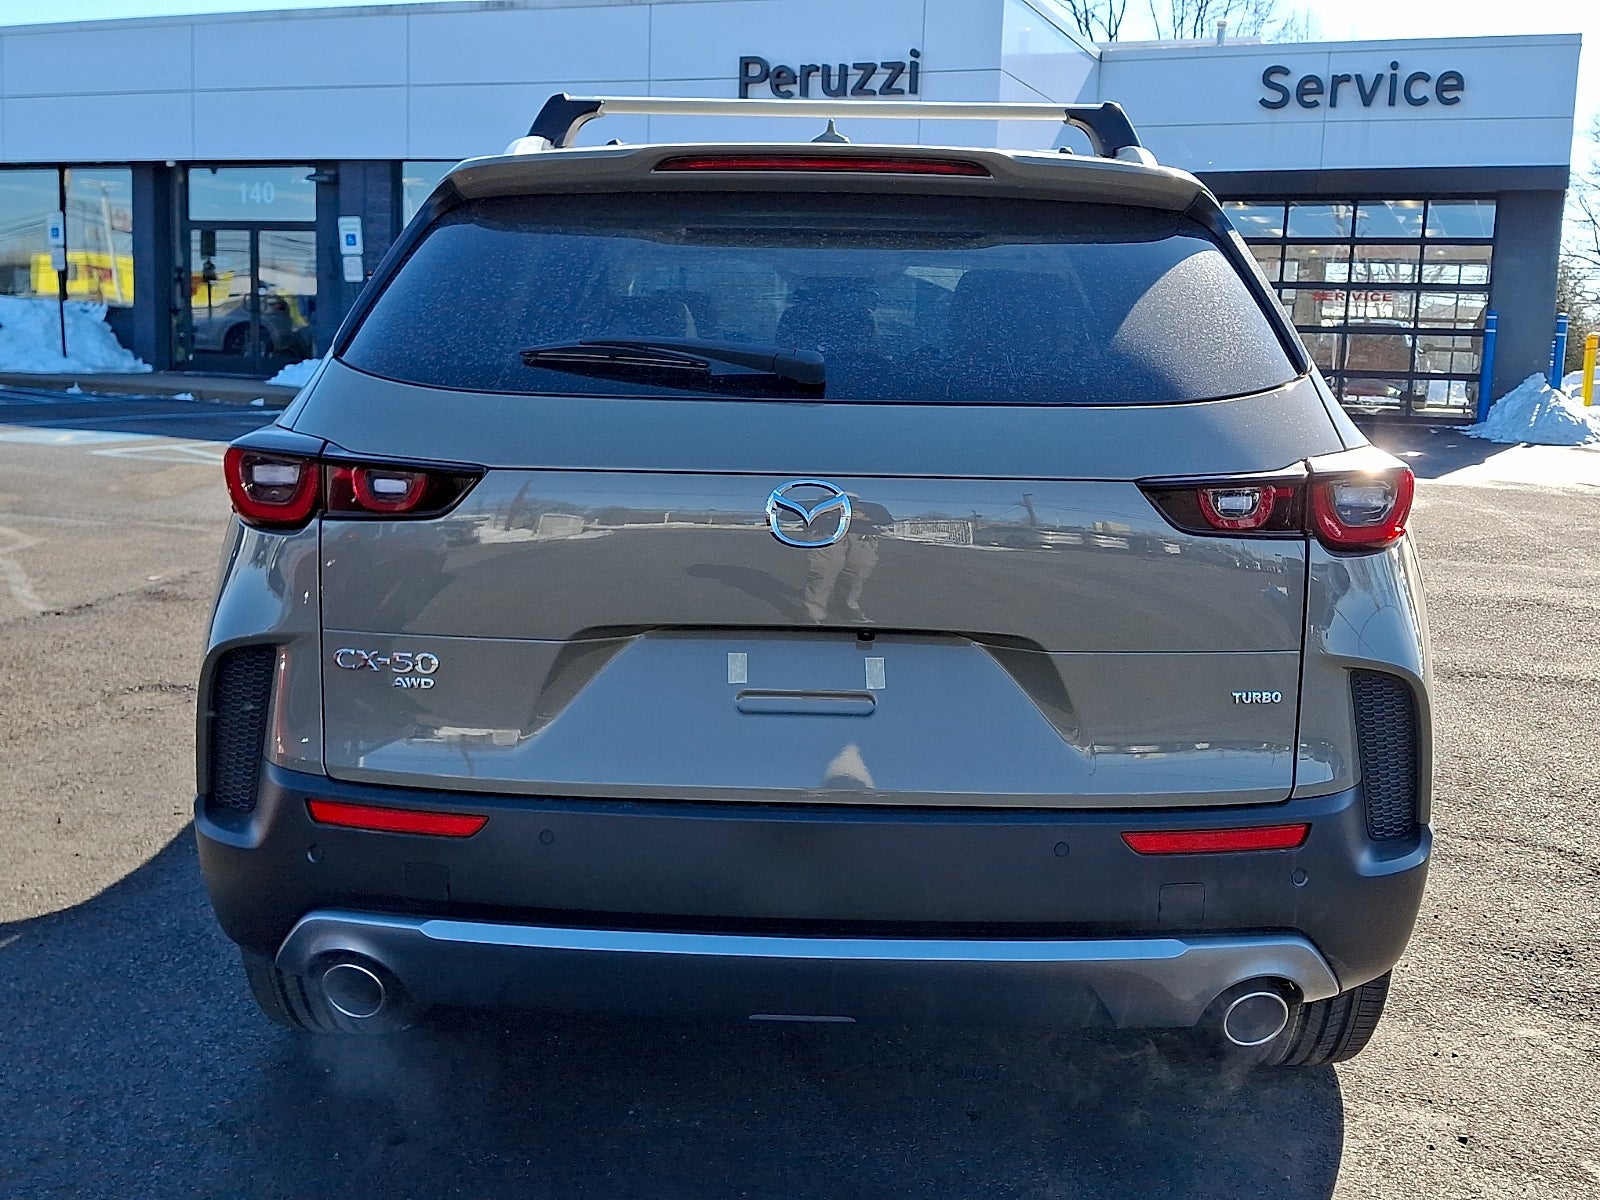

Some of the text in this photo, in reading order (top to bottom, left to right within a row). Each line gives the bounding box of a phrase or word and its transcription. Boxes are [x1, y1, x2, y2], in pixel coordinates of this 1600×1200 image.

[738, 48, 921, 99] Peruzzi
[1258, 60, 1466, 110] Service
[240, 181, 275, 205] 140
[1312, 291, 1393, 302] SERVICE
[333, 648, 440, 675] CX-50
[392, 676, 436, 690] AWD
[1231, 690, 1283, 705] TURBO
